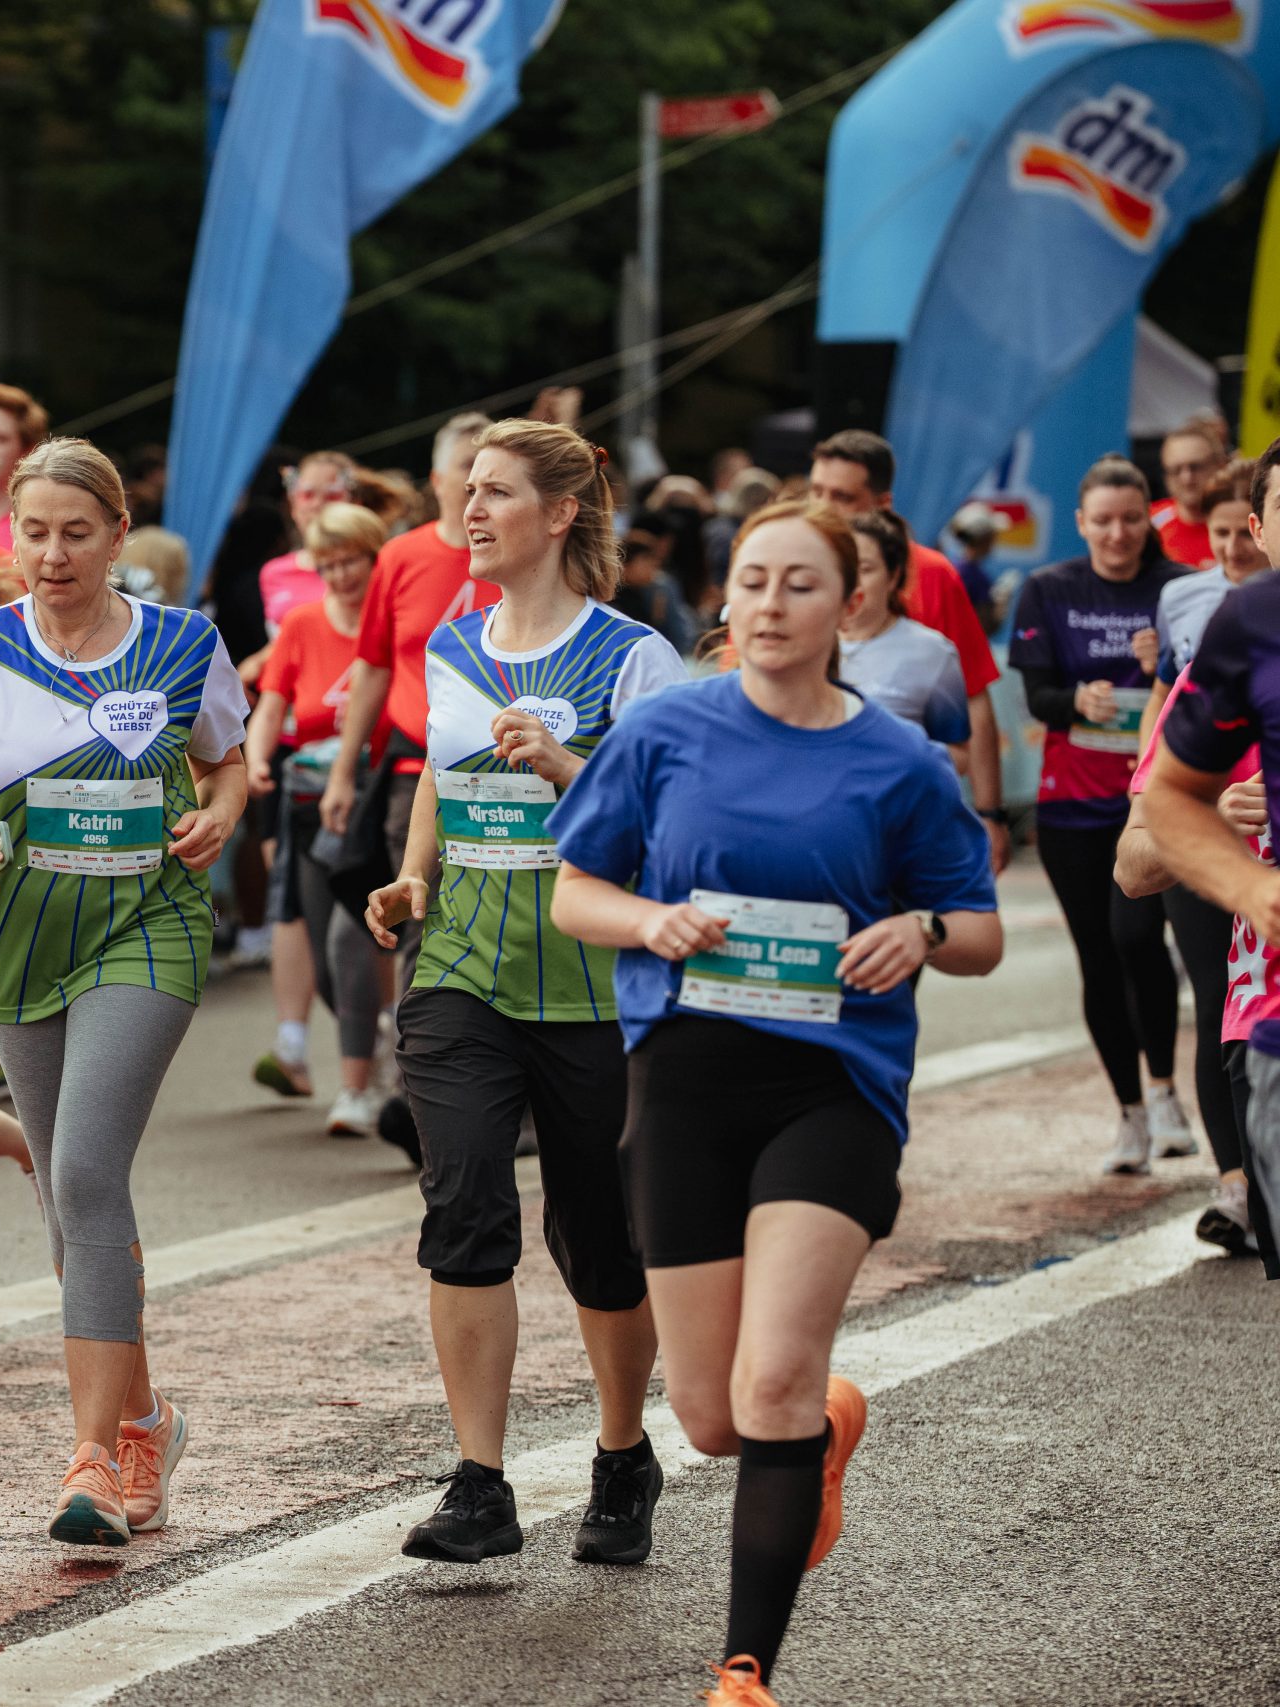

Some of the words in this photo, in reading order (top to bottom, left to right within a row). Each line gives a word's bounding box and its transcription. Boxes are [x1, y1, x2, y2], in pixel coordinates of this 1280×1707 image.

[1064, 101, 1174, 191] dm
[103, 700, 159, 712] SCHÜTZE,
[108, 712, 135, 721] WAS
[138, 711, 153, 720] DU
[110, 722, 152, 732] LIEBST.
[543, 720, 559, 730] DU
[467, 804, 525, 823] Kirsten
[68, 812, 123, 831] Katrin
[484, 826, 508, 837] 5026
[82, 834, 109, 844] 4956
[768, 940, 820, 966] Lena
